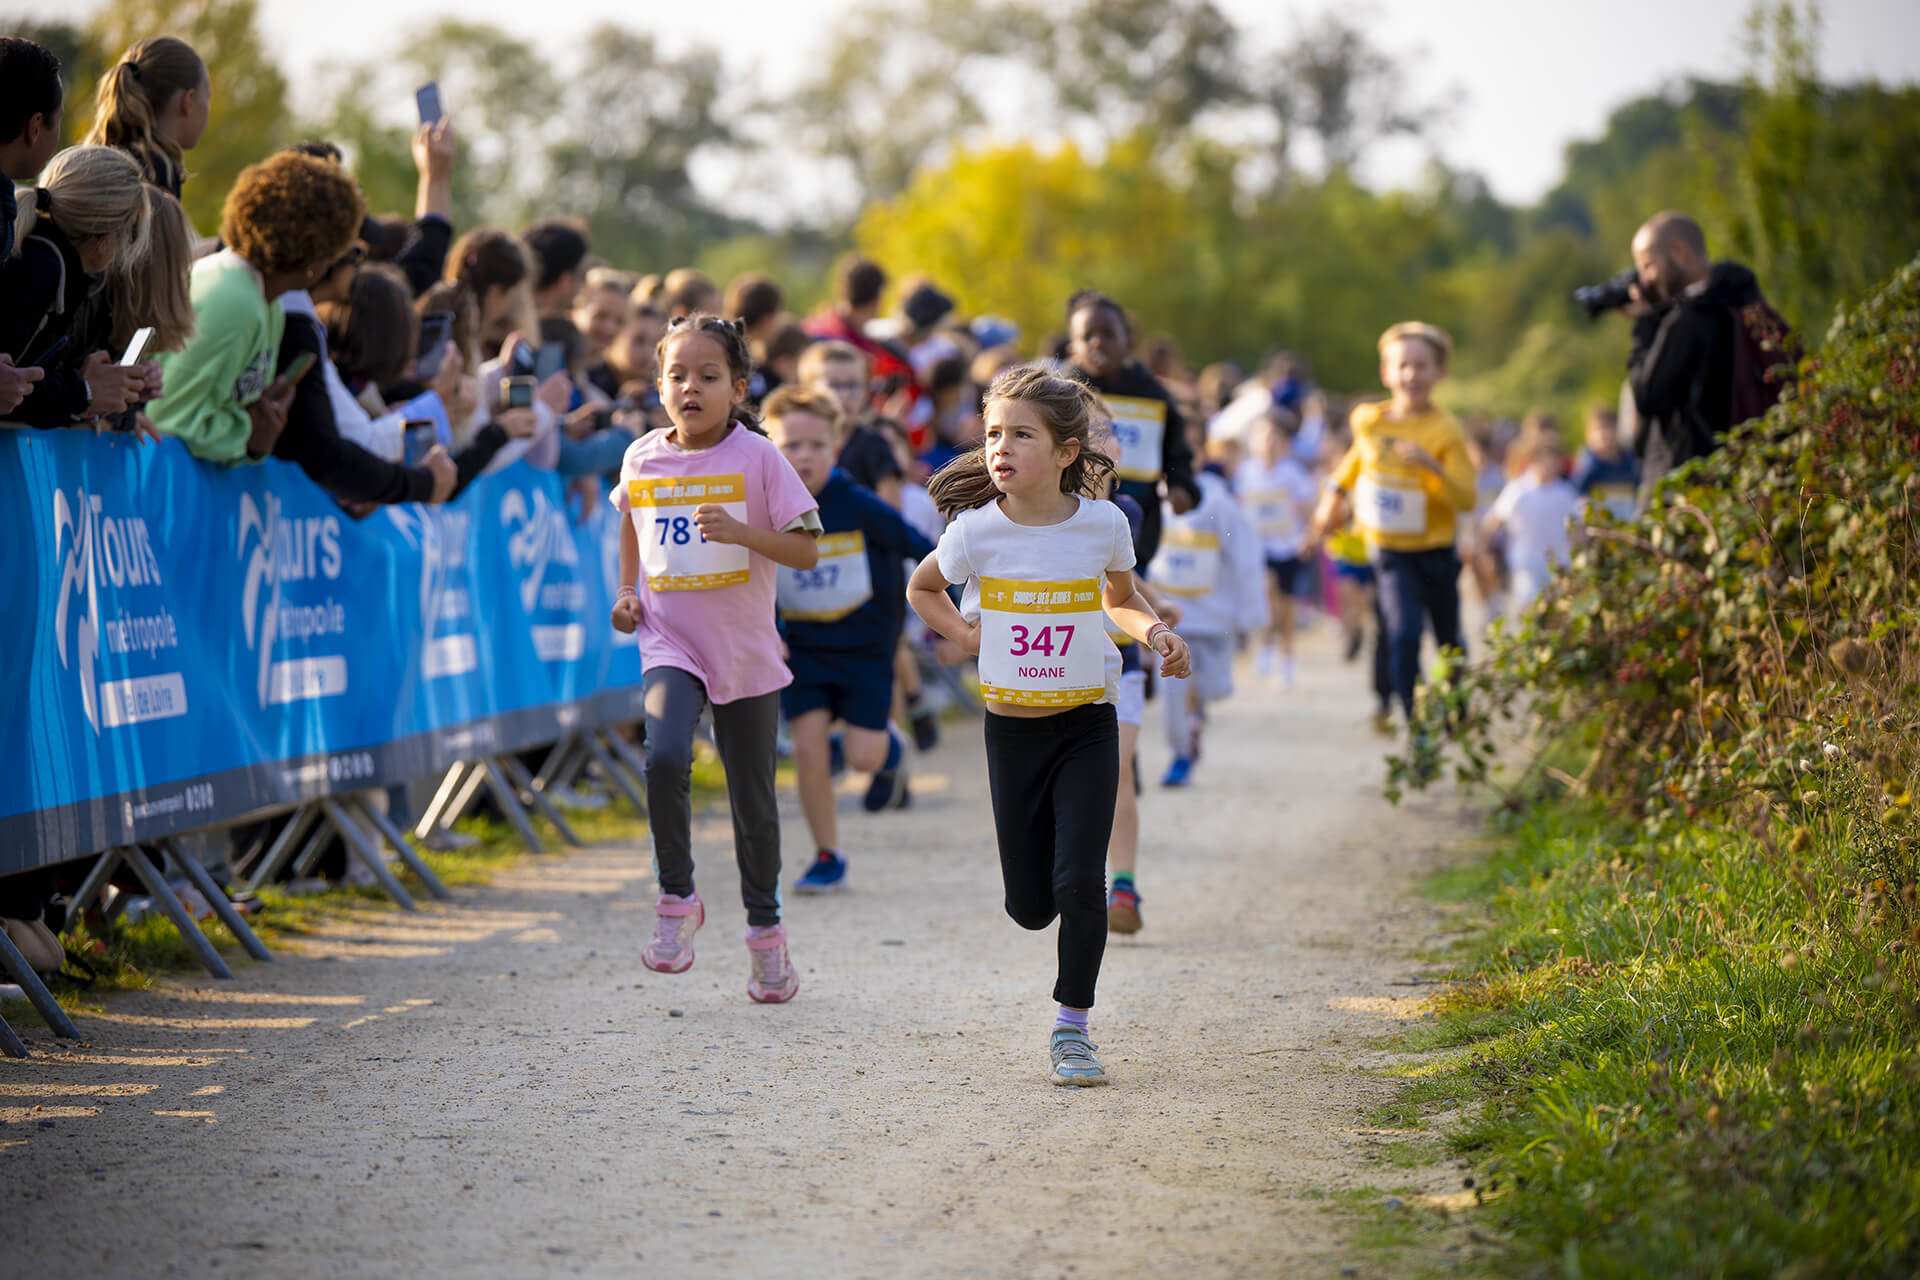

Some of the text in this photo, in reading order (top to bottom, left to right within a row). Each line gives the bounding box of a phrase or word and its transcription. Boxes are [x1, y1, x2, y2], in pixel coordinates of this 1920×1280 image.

[88, 494, 162, 588] Tours
[105, 604, 179, 660] métropole
[1010, 625, 1075, 657] 347
[1018, 666, 1065, 678] NOANE
